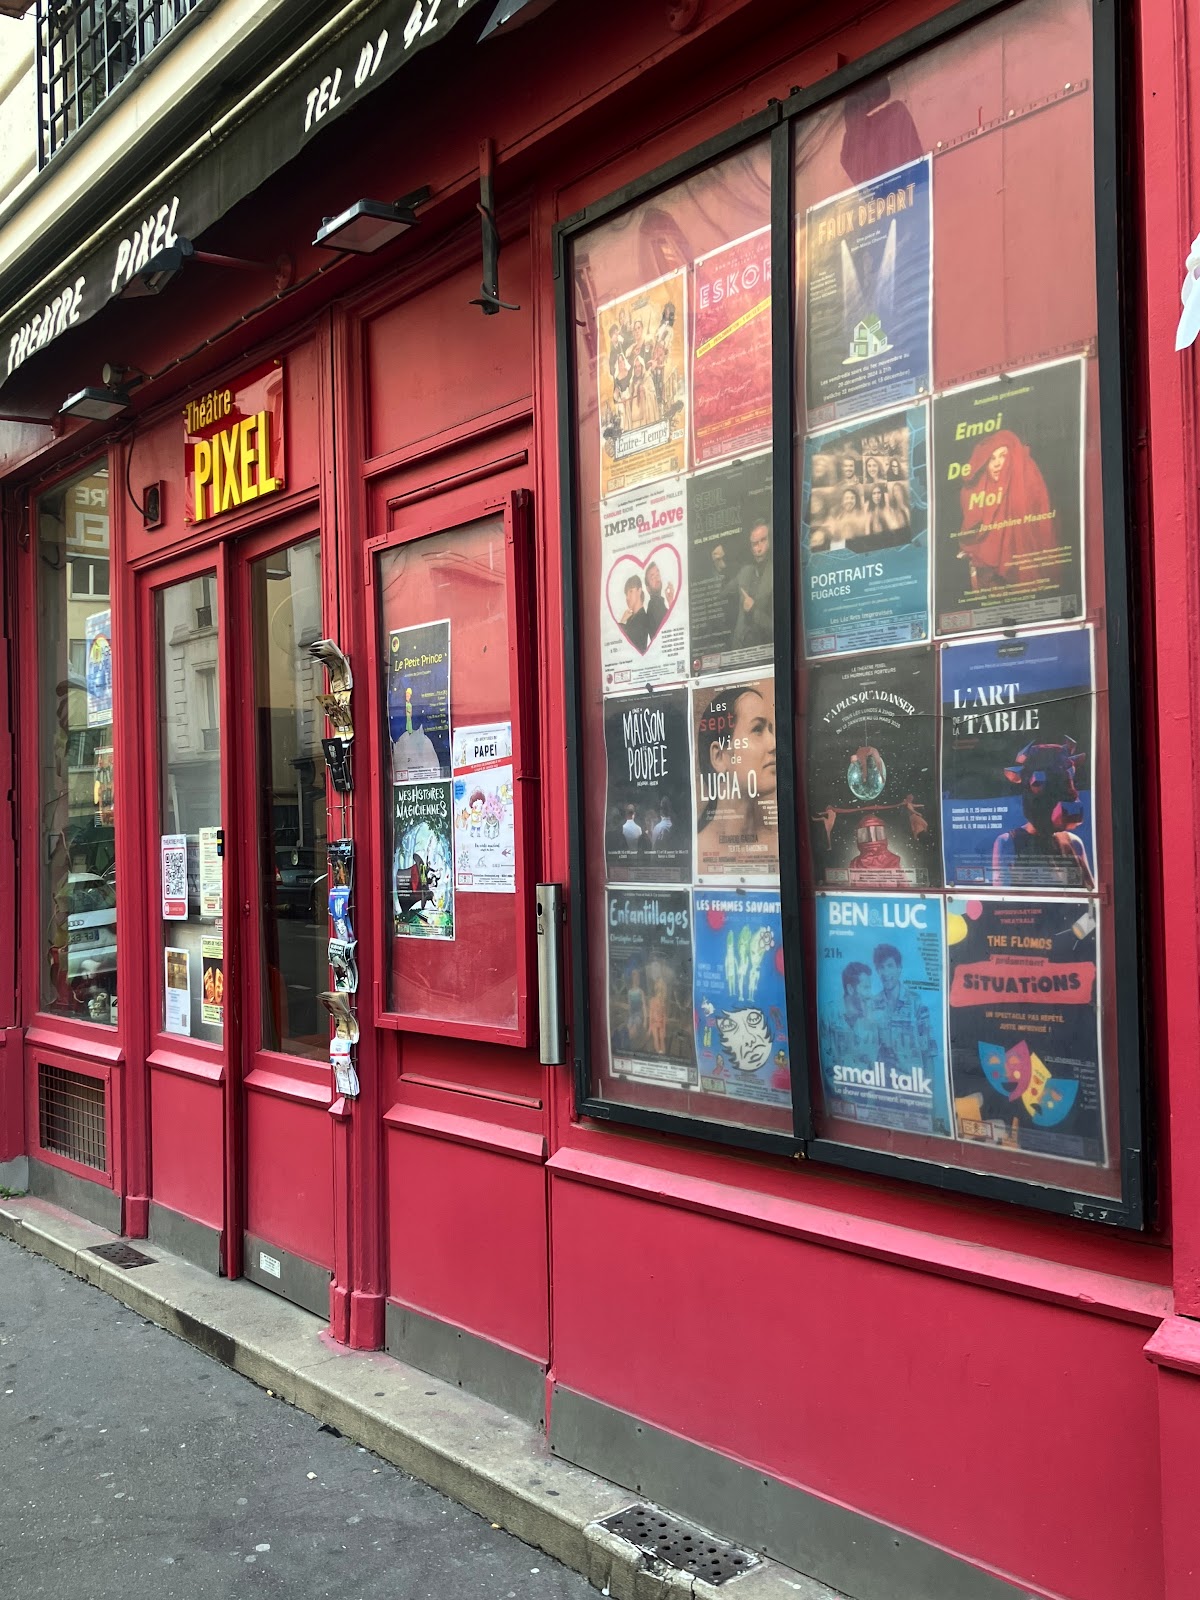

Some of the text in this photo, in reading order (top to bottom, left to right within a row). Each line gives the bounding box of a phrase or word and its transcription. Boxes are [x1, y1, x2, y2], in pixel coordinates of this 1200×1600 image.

[7, 276, 87, 376] THEATRE
[111, 196, 181, 293] PIXEL
[304, 67, 344, 132] TEL
[354, 29, 389, 89] 01
[818, 209, 855, 244] FAUX
[186, 389, 232, 435] Théâtre
[955, 412, 1003, 441] Emoi
[617, 428, 669, 454] Entre-Temps
[194, 410, 279, 522] PIXEL
[947, 462, 972, 481] De
[967, 487, 1003, 511] Moi
[651, 507, 684, 528] Love
[810, 563, 883, 589] PORTRAITS
[811, 585, 851, 601] FUGACES
[395, 653, 443, 671] Le Petit Prince
[710, 702, 727, 713] Les
[836, 694, 858, 711] PLUS
[879, 690, 916, 715] DANSER
[953, 682, 1020, 709] L'ART
[699, 714, 737, 732] sept
[963, 708, 1040, 736] TABLE
[627, 741, 669, 781] POUPÉE
[730, 754, 742, 765] de
[700, 769, 760, 802] LUCIA O.
[609, 898, 689, 936] Enfantillages
[696, 899, 709, 912] LES
[711, 900, 744, 913] FEMMES
[829, 901, 868, 927] BEN
[882, 902, 927, 929] LUC
[824, 948, 842, 959] 21h
[986, 935, 1052, 950] THE FLOMOS
[833, 1061, 932, 1095] small talk
